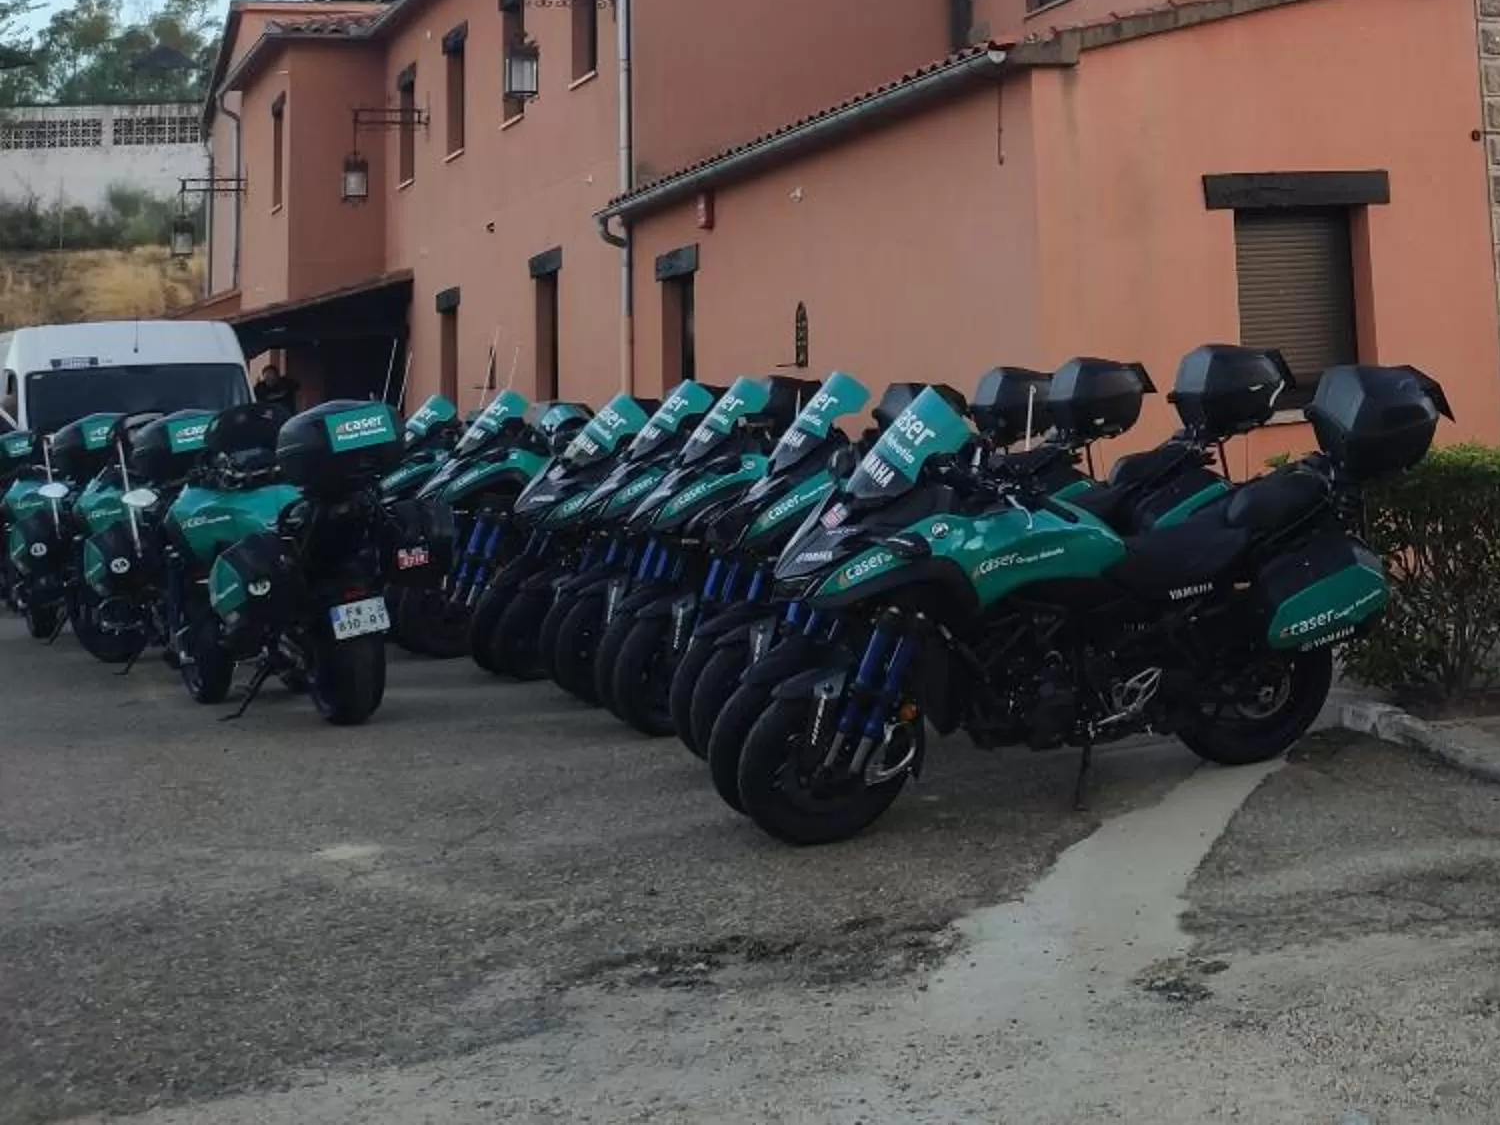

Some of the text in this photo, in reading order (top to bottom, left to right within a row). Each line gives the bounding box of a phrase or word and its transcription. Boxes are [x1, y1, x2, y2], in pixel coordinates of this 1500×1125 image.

[846, 552, 886, 580] caser
[1168, 581, 1214, 601] YAMAHA
[1289, 608, 1335, 636] caser
